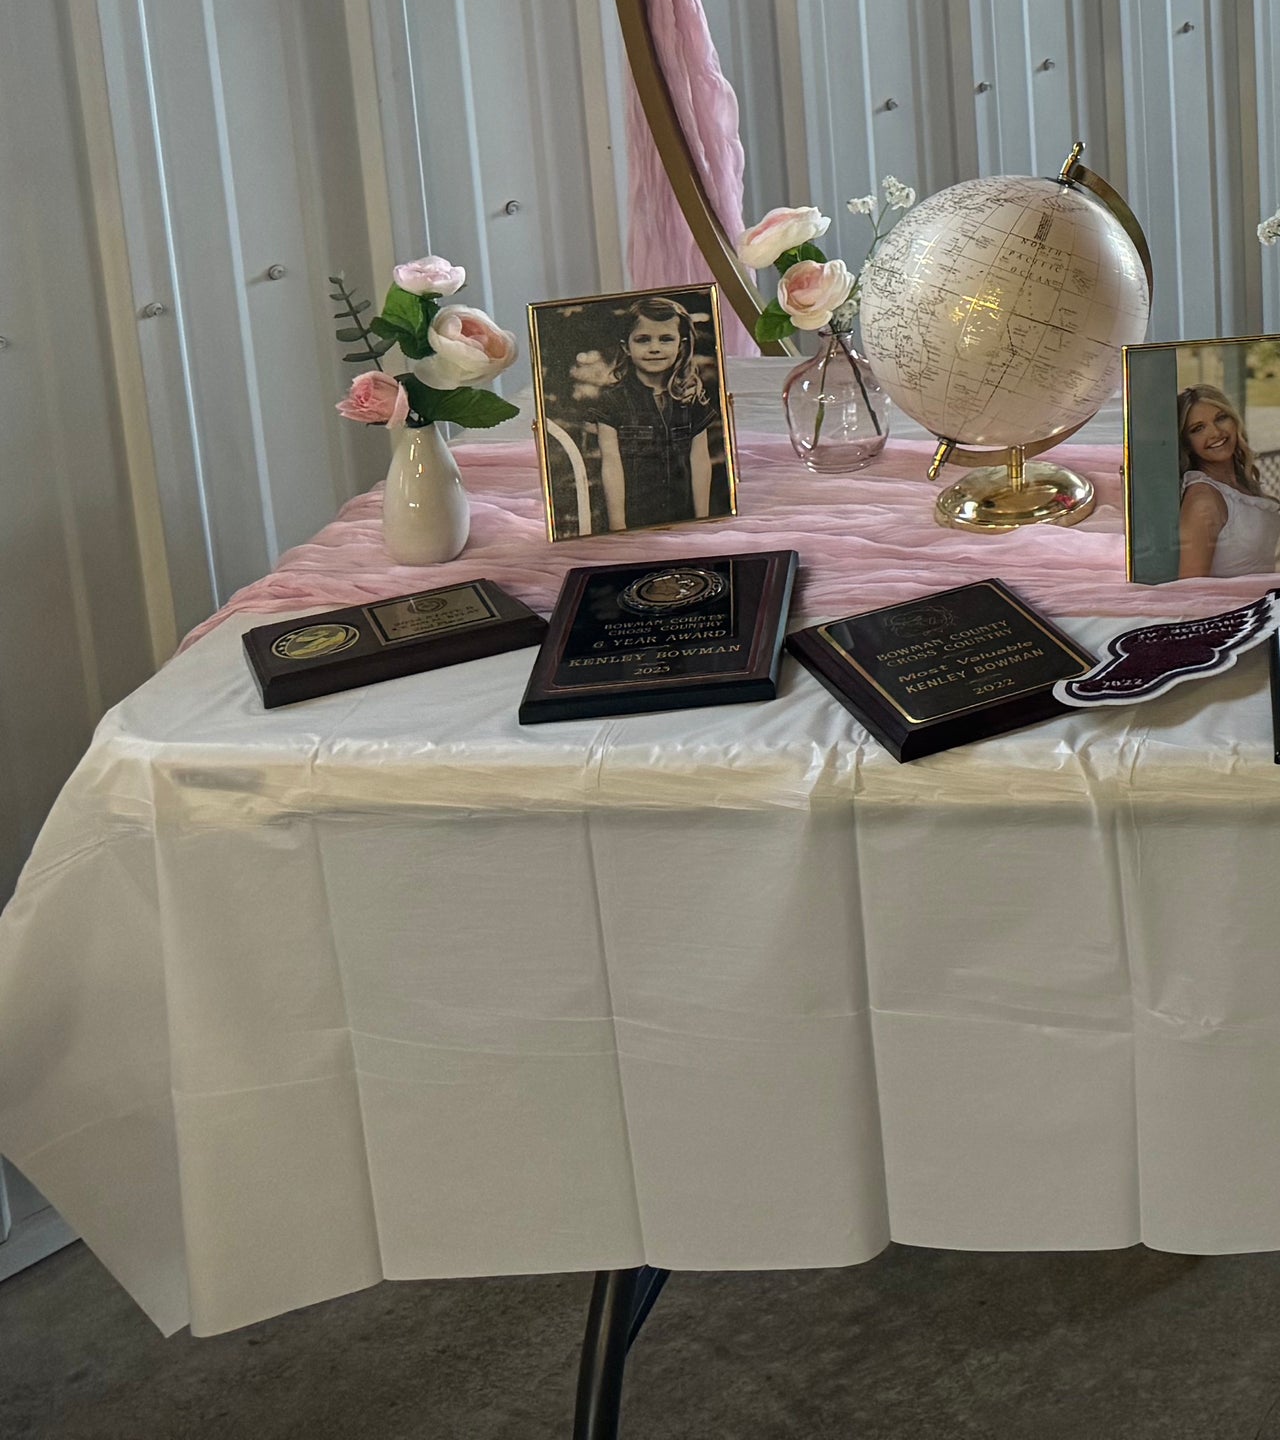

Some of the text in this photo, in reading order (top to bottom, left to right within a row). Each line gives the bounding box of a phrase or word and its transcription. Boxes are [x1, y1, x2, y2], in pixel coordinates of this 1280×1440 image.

[604, 614, 726, 630] BOWMAN COUNTY
[608, 621, 723, 636] CROSS COUNTRY
[613, 636, 657, 647] YEAR
[665, 630, 727, 642] AWARD
[876, 620, 1008, 662] BOWMAN COUNTY
[887, 628, 1013, 667] CROSS COUNTRY
[568, 645, 741, 667] KENLEY BOWMAN
[899, 641, 1033, 683] Most Valuable
[905, 648, 1045, 694] KENLEY BOWMAN
[972, 678, 1015, 695] 2022
